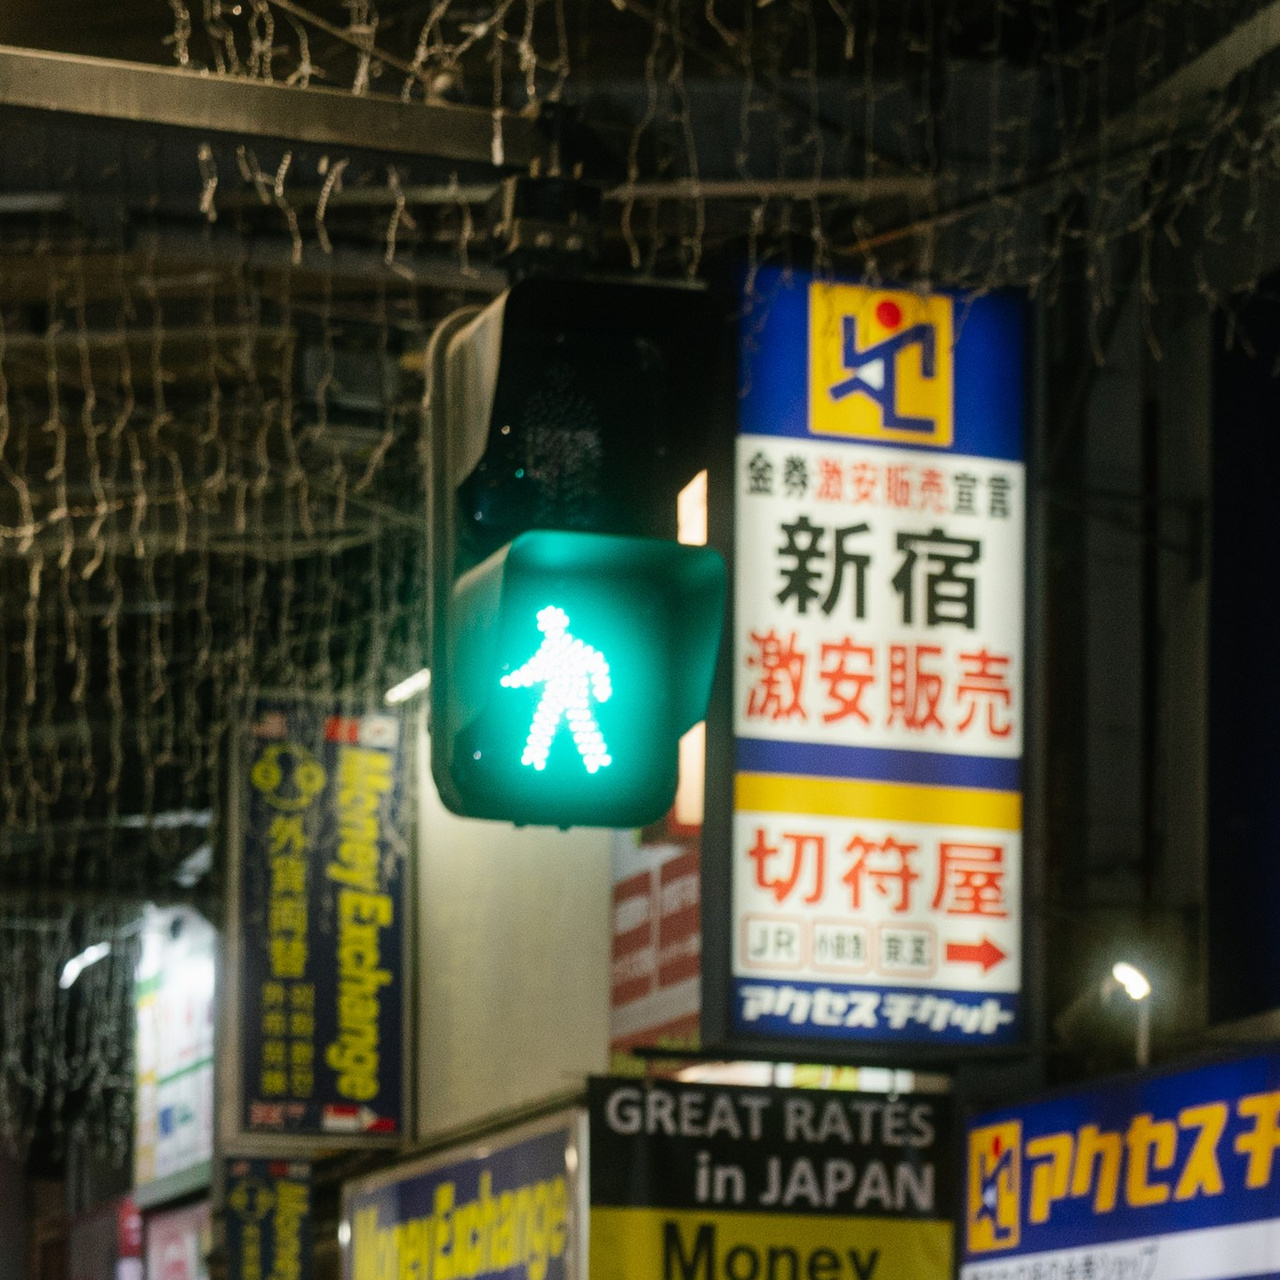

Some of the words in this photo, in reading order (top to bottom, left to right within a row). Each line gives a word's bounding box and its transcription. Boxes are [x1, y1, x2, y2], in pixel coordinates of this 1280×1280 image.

[776, 515, 983, 631] 新宿
[746, 629, 1012, 738] 激安販売
[326, 746, 394, 892] Money
[748, 828, 1010, 919] 切符屋
[750, 927, 796, 958] JR
[326, 890, 394, 1101] Exchange
[739, 985, 1015, 1035] アクセスチケット
[605, 1088, 770, 1142] GREAT
[785, 1100, 936, 1150] RATES
[696, 1150, 747, 1203] in
[760, 1155, 936, 1212] JAPAN
